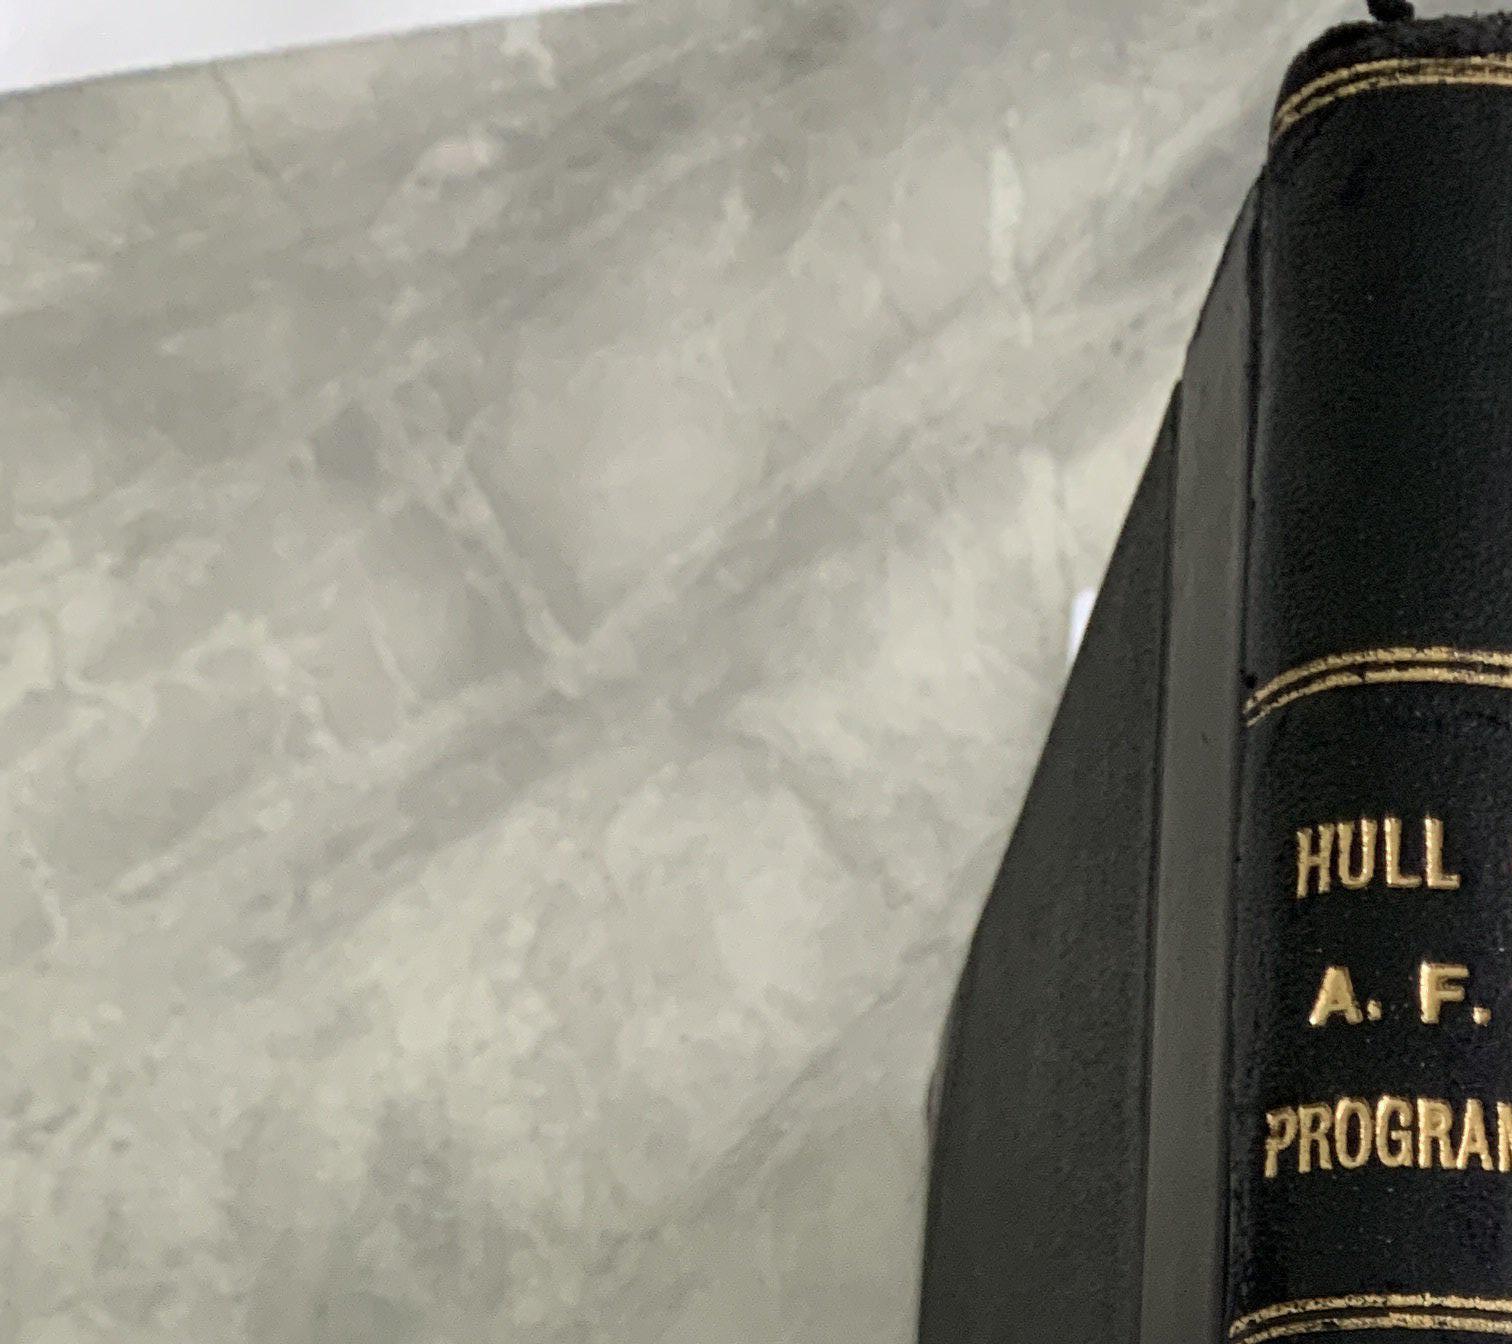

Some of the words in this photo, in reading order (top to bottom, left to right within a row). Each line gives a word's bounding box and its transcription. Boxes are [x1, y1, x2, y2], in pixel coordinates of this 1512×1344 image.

[1296, 815, 1460, 899] HULL
[1308, 965, 1382, 1027] A.
[1418, 959, 1492, 1026] F.
